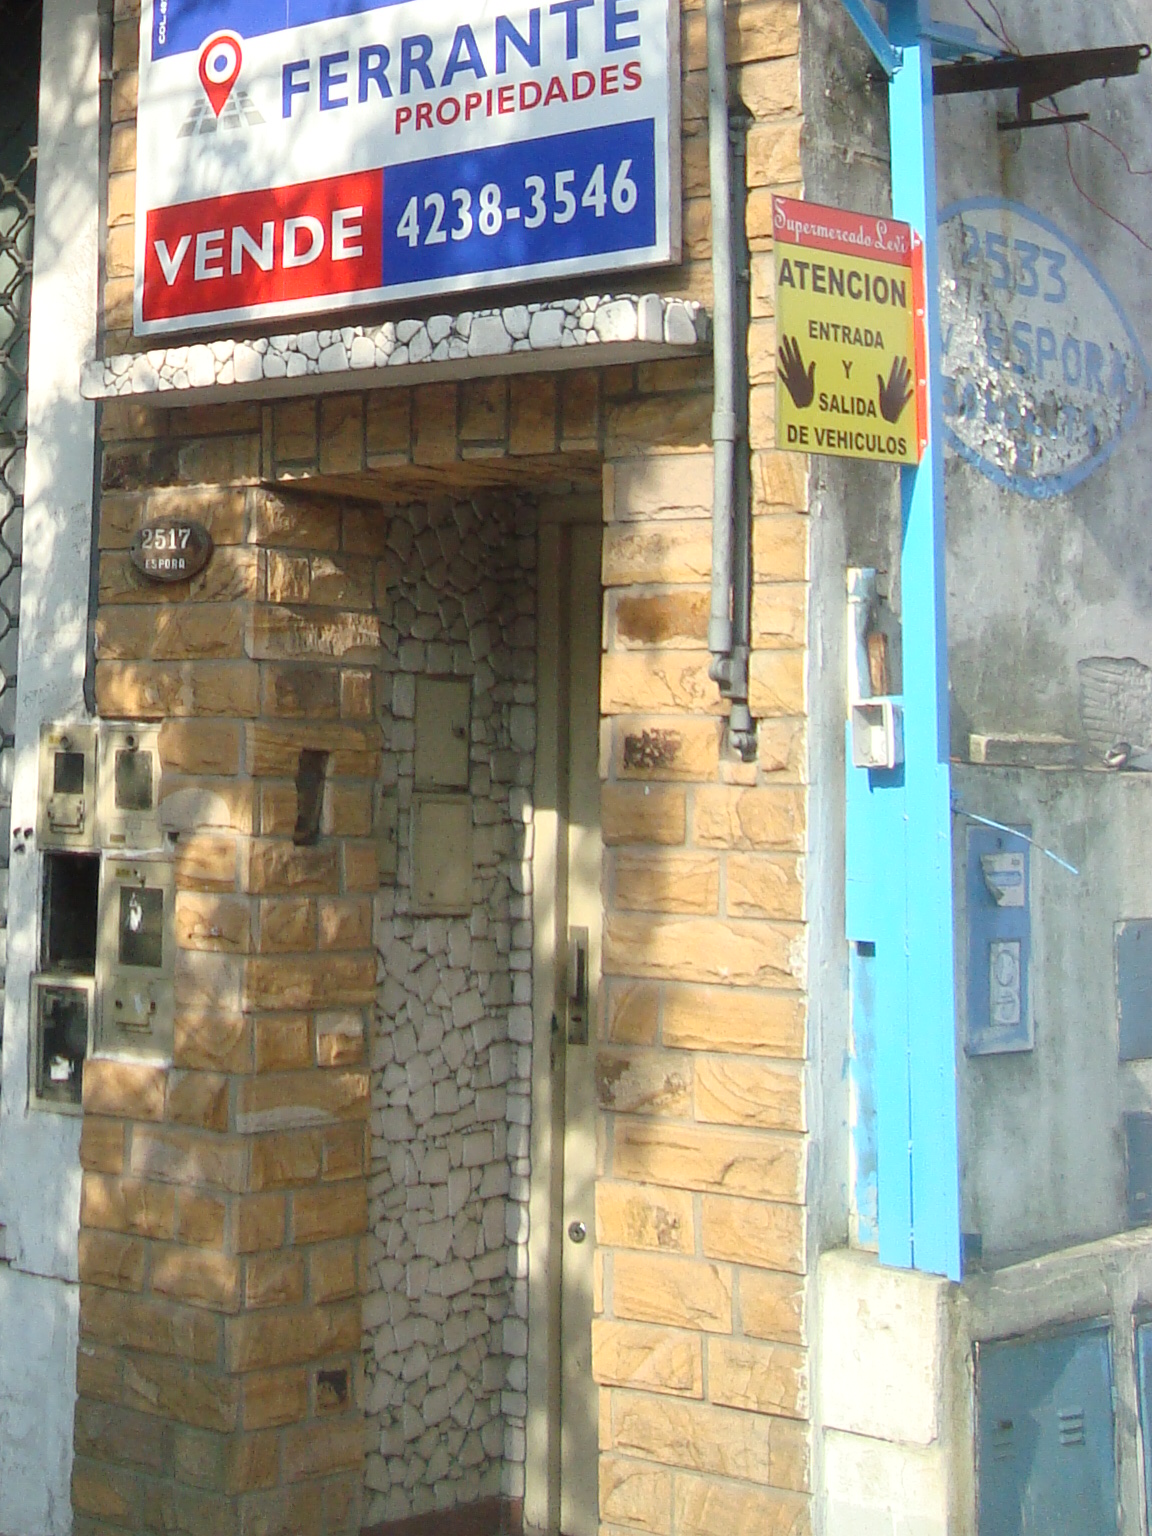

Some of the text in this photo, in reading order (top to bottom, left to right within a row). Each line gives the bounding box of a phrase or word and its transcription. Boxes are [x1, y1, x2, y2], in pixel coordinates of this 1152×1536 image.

[395, 61, 643, 135] PROPIEDADES
[396, 159, 638, 248] 4238-3546
[774, 198, 872, 247] Supermercado
[153, 205, 364, 286] VENDE
[778, 258, 907, 308] ATENCION
[808, 319, 885, 350] ENTRADA
[842, 359, 854, 379] Y
[818, 392, 878, 418] SALIDA
[787, 424, 908, 455] DE VEHICULOS
[142, 528, 191, 550] 2517
[145, 557, 186, 570] ESPORA
